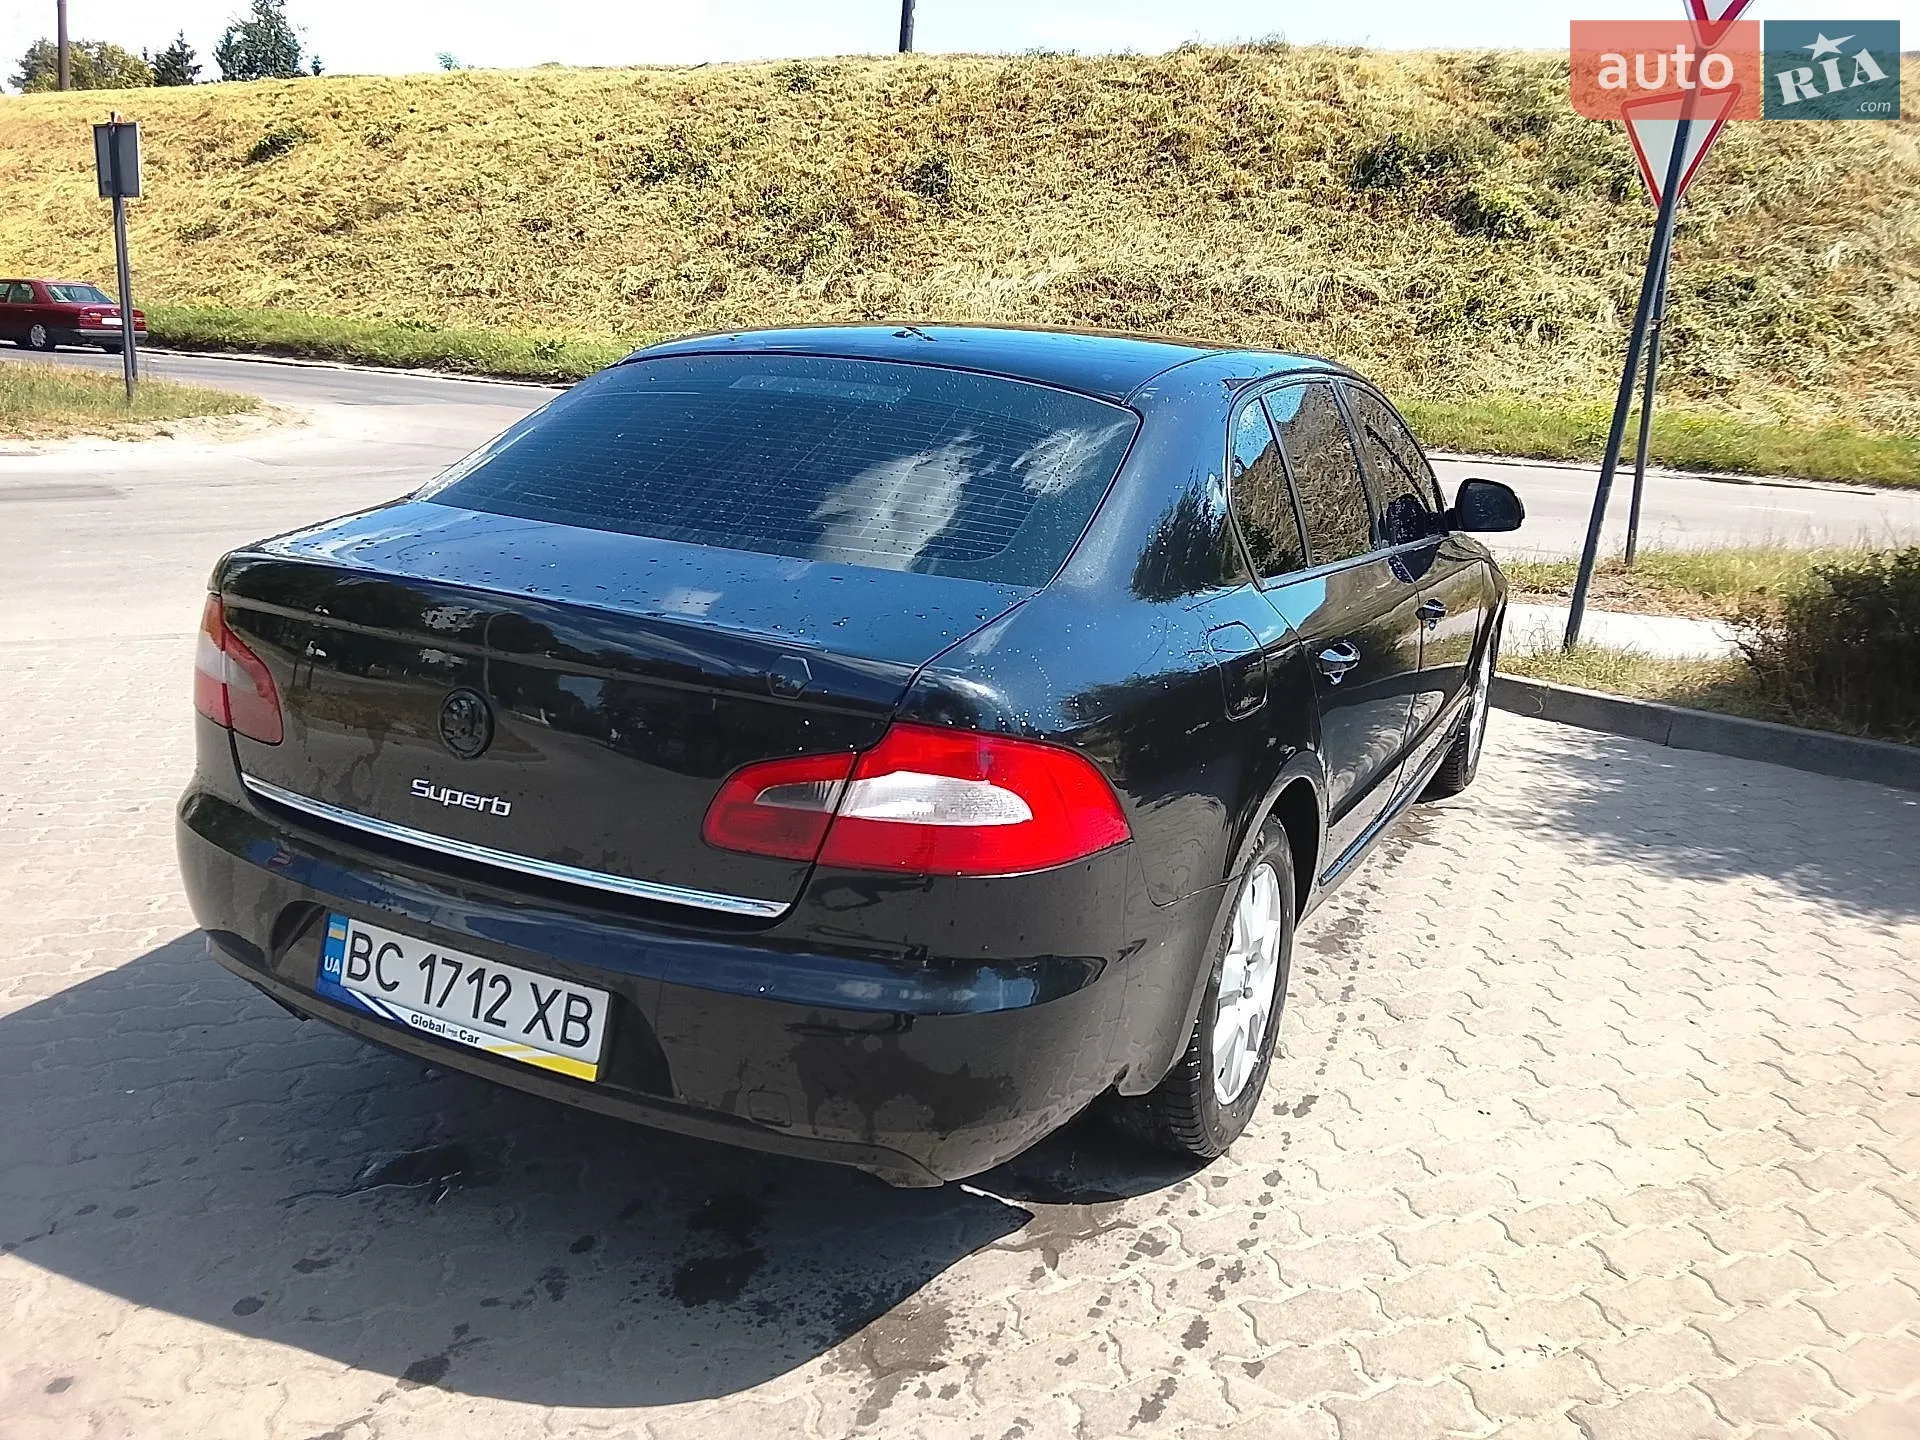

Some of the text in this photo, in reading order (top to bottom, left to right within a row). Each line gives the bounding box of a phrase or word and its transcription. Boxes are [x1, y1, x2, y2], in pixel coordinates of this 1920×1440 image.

[410, 778, 512, 817] Superb
[323, 955, 341, 975] UA
[347, 930, 593, 1048] BC 1712 XB
[411, 1014, 446, 1034] Global
[459, 1029, 481, 1044] Car
